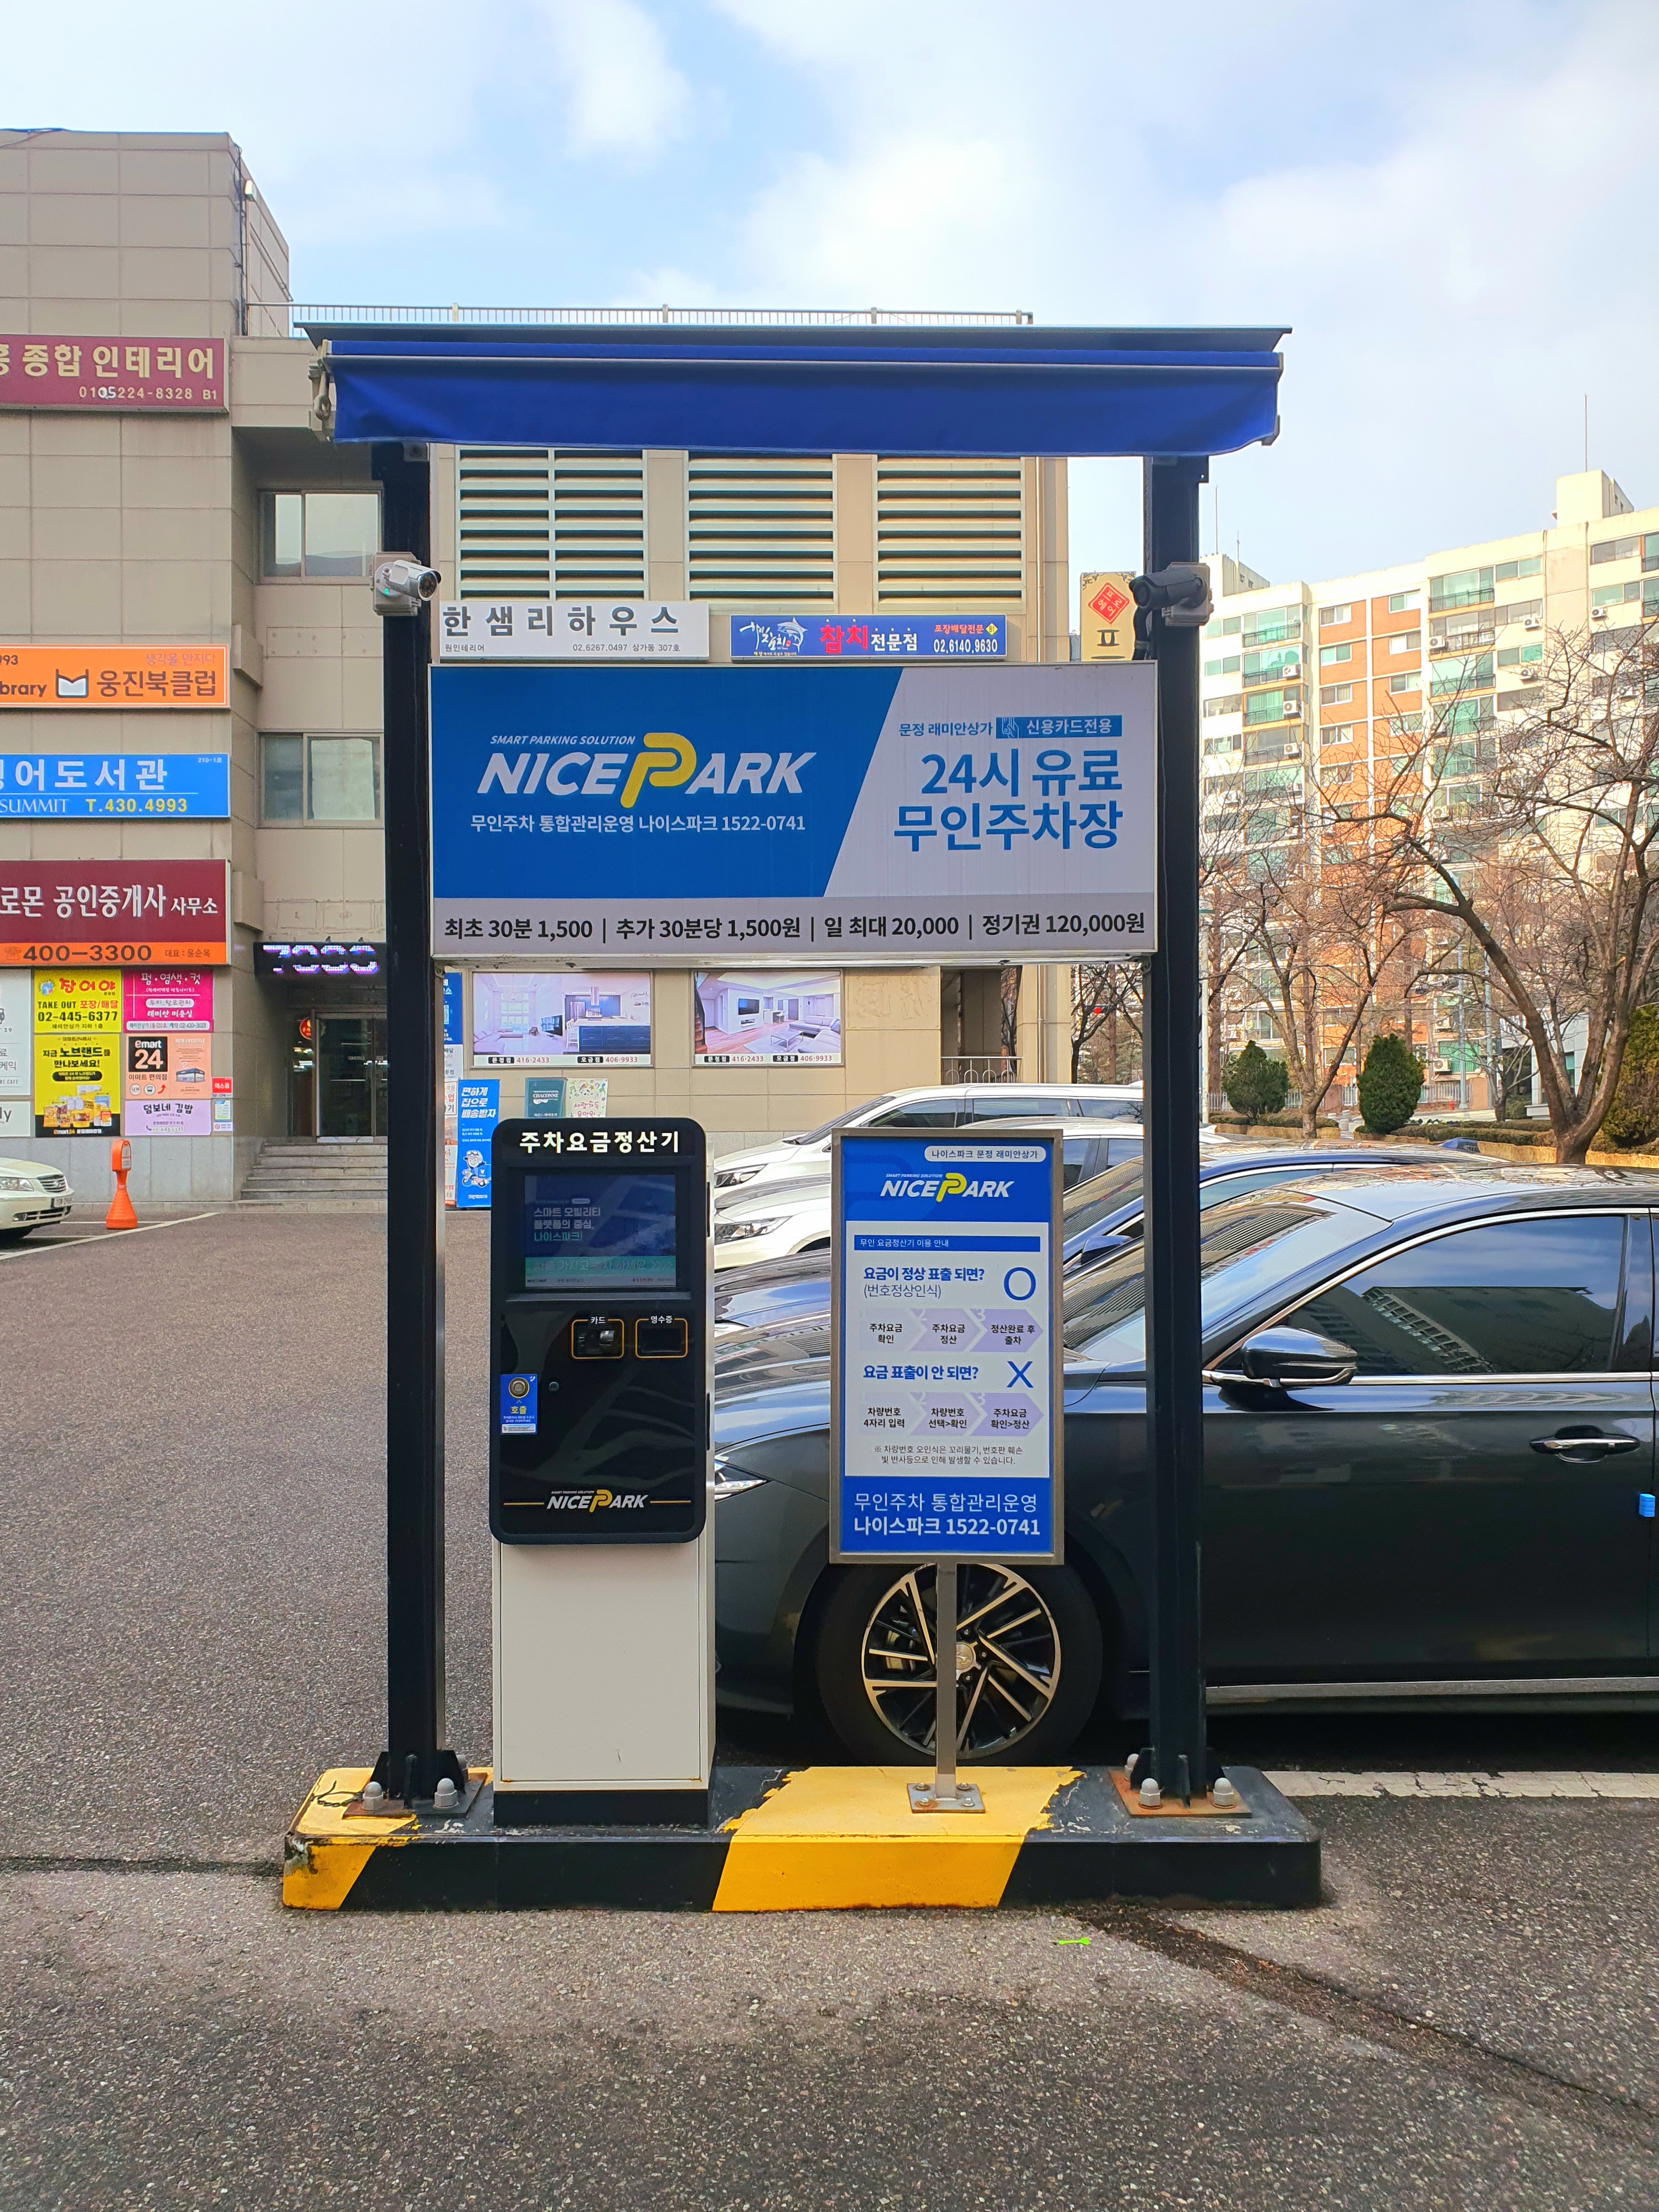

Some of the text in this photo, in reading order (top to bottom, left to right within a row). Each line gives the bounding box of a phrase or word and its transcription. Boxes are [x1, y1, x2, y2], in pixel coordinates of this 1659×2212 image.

[22, 344, 81, 377] 종합
[92, 346, 213, 379] 인테리어
[202, 390, 217, 400] B1
[442, 605, 679, 637] 한샘리하우스
[819, 625, 868, 653] 참치
[870, 633, 918, 652] 전문점
[934, 624, 984, 634] 포장배달전문
[445, 643, 681, 652] 원인테리어 02.6267.0497 상가동 307호
[96, 669, 216, 697] 웅진북클럽
[898, 719, 1112, 737] 문정 래미안상가 신용카드전용
[490, 735, 635, 746] SMART PARKING SOLUTION
[0, 759, 168, 792] 어도서관
[921, 748, 1123, 797] 24시 유료
[0, 798, 188, 814] SUMMIT T.430.4993
[471, 815, 805, 833] 무인주차 통합관리운영 나이스파크 1522-0741
[893, 800, 1123, 852] 무인주차장
[53, 884, 167, 918] 공인중개사
[170, 896, 219, 917] 사무소
[445, 912, 1146, 942] 최초 30분 1,500 추가 30분당 1,500원 일 최대 20,000 정기권 120,000원
[23, 944, 152, 962] 400-3300
[164, 949, 180, 958] 대표
[59, 978, 116, 994] 장어야
[38, 1000, 118, 1009] TAKE OUT 포장/배달
[38, 1011, 118, 1022] 02-445-6377
[147, 1009, 193, 1018] 래미안 미용실
[135, 1040, 162, 1048] emart
[54, 1060, 100, 1068] 만나보세요!
[135, 1049, 164, 1069] 24
[461, 1087, 489, 1097] 편하게
[461, 1098, 488, 1108] 집으로
[143, 1103, 193, 1114] 덤보네 김밥
[461, 1109, 497, 1119] 배송받자
[519, 1131, 679, 1154] 주차요금정산기
[931, 1149, 1038, 1159] 나이스파크 문정 래미안상가
[880, 1172, 1015, 1202] NICEPARK
[534, 1207, 601, 1217] 스마트 모빌리티
[534, 1219, 571, 1229] 플랫폼의
[860, 1238, 949, 1248] 무인 요금정산기 이용 안내
[864, 1267, 985, 1281] 요금이 정상 표출 되면?
[864, 1284, 942, 1299] (번호정상인식)
[590, 1316, 606, 1325] 카드
[650, 1315, 673, 1324] 영수증
[869, 1323, 903, 1333] 주차요금
[932, 1324, 965, 1334] 주차요금
[991, 1324, 1036, 1334] 정산완료 후
[877, 1334, 895, 1344] 확인
[940, 1335, 957, 1345] 정산
[1005, 1336, 1022, 1345] 출차
[863, 1365, 888, 1379] 요금
[891, 1365, 928, 1380] 표출이
[931, 1366, 944, 1380] 안
[947, 1366, 979, 1380] 되면?
[511, 1406, 527, 1414] 호출
[867, 1407, 902, 1417] 차량번호
[931, 1407, 965, 1417] 차량번호
[993, 1408, 1027, 1418] 주차요금
[864, 1418, 906, 1428] 4자리 입력
[928, 1419, 968, 1429] 선택>확인
[990, 1419, 1030, 1429] 확인>정산
[883, 1445, 1024, 1455] 차량번호 오인식은 꼬리물기, 번호판 훼손
[891, 1455, 929, 1465] 반사등으로
[931, 1455, 946, 1465] 인해
[948, 1455, 971, 1465] 발생할
[973, 1456, 981, 1465] 수
[983, 1455, 1016, 1465] 있습니다.
[546, 1489, 649, 1513] NICEPARK
[854, 1492, 1037, 1513] 무인주차 통합관리운영
[854, 1516, 1041, 1536] 나이스파크 1522-0741
